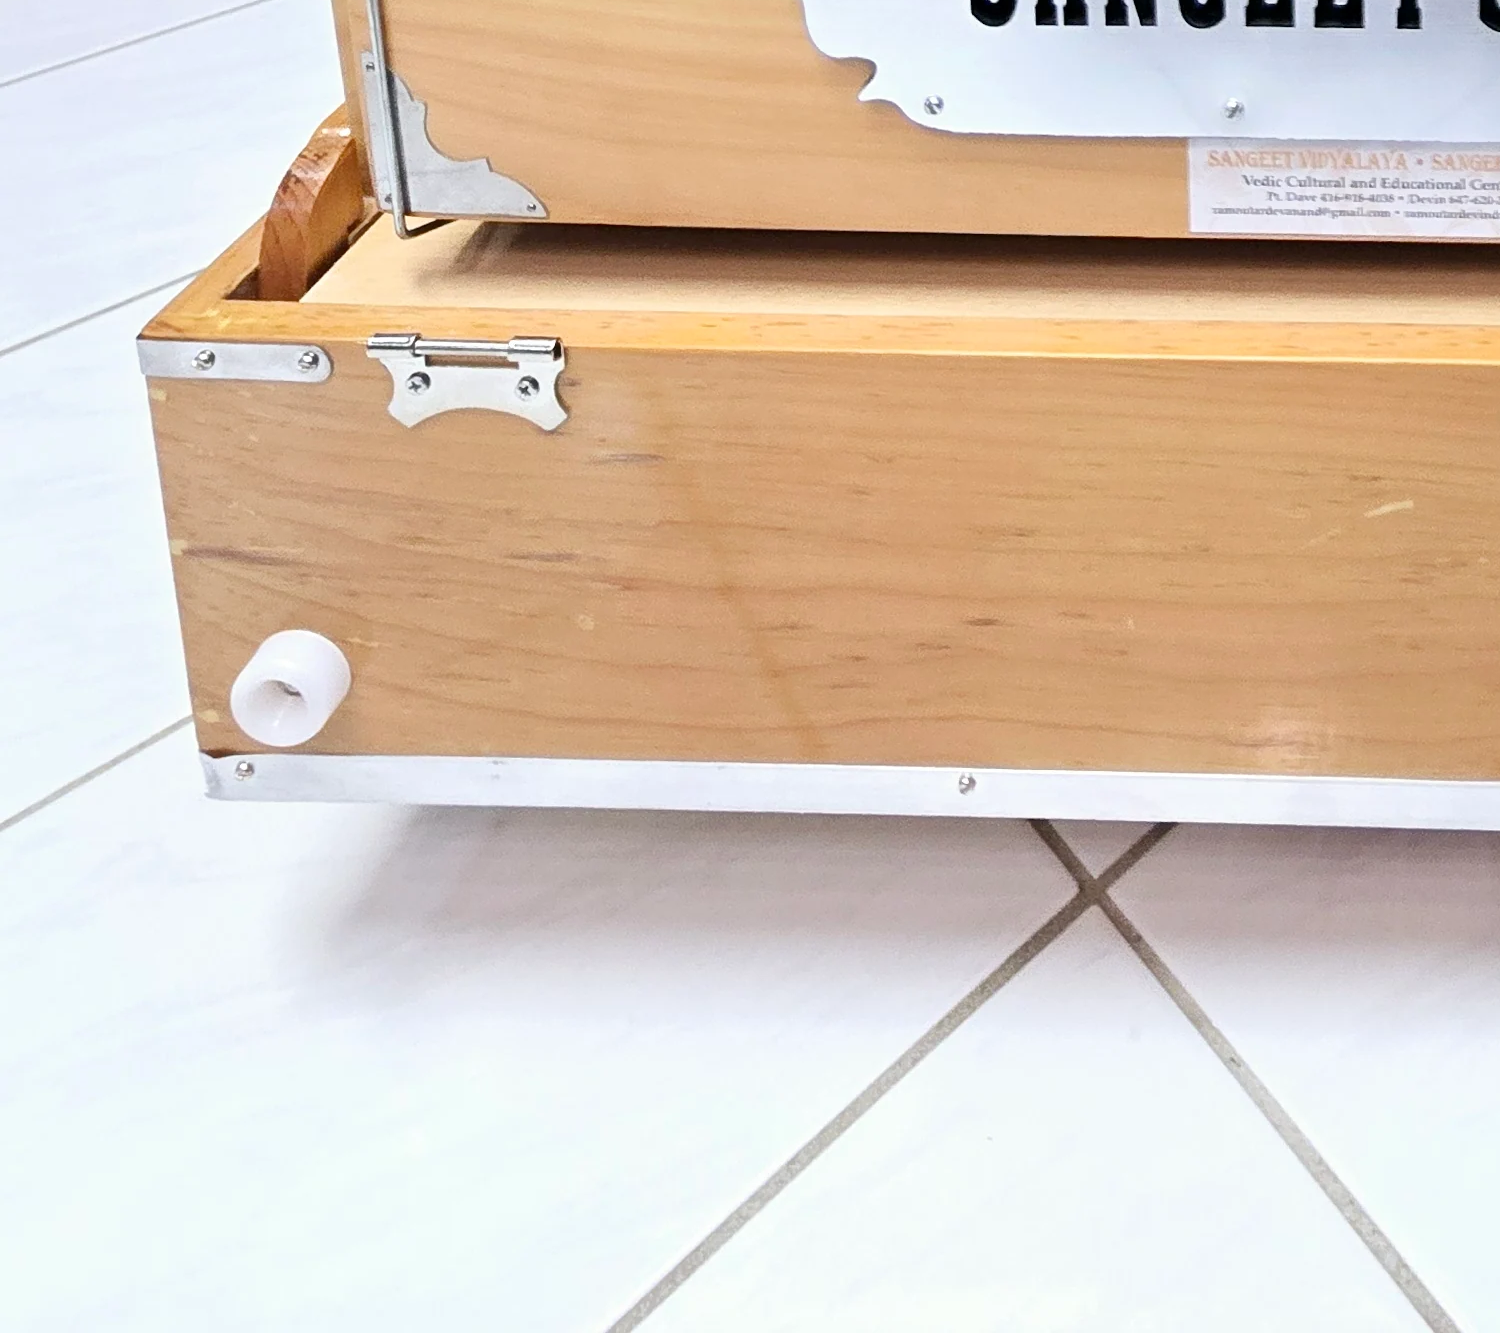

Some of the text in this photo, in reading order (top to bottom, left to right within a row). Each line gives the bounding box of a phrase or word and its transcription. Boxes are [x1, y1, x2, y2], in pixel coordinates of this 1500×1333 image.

[1207, 150, 1294, 169] SANGEET
[1300, 150, 1409, 171] VIDYALAYA
[1241, 174, 1283, 188] Vedic
[1284, 175, 1346, 189] Cultural
[1350, 176, 1377, 190] and
[1380, 177, 1467, 191] Educational
[1286, 191, 1318, 203] Dave
